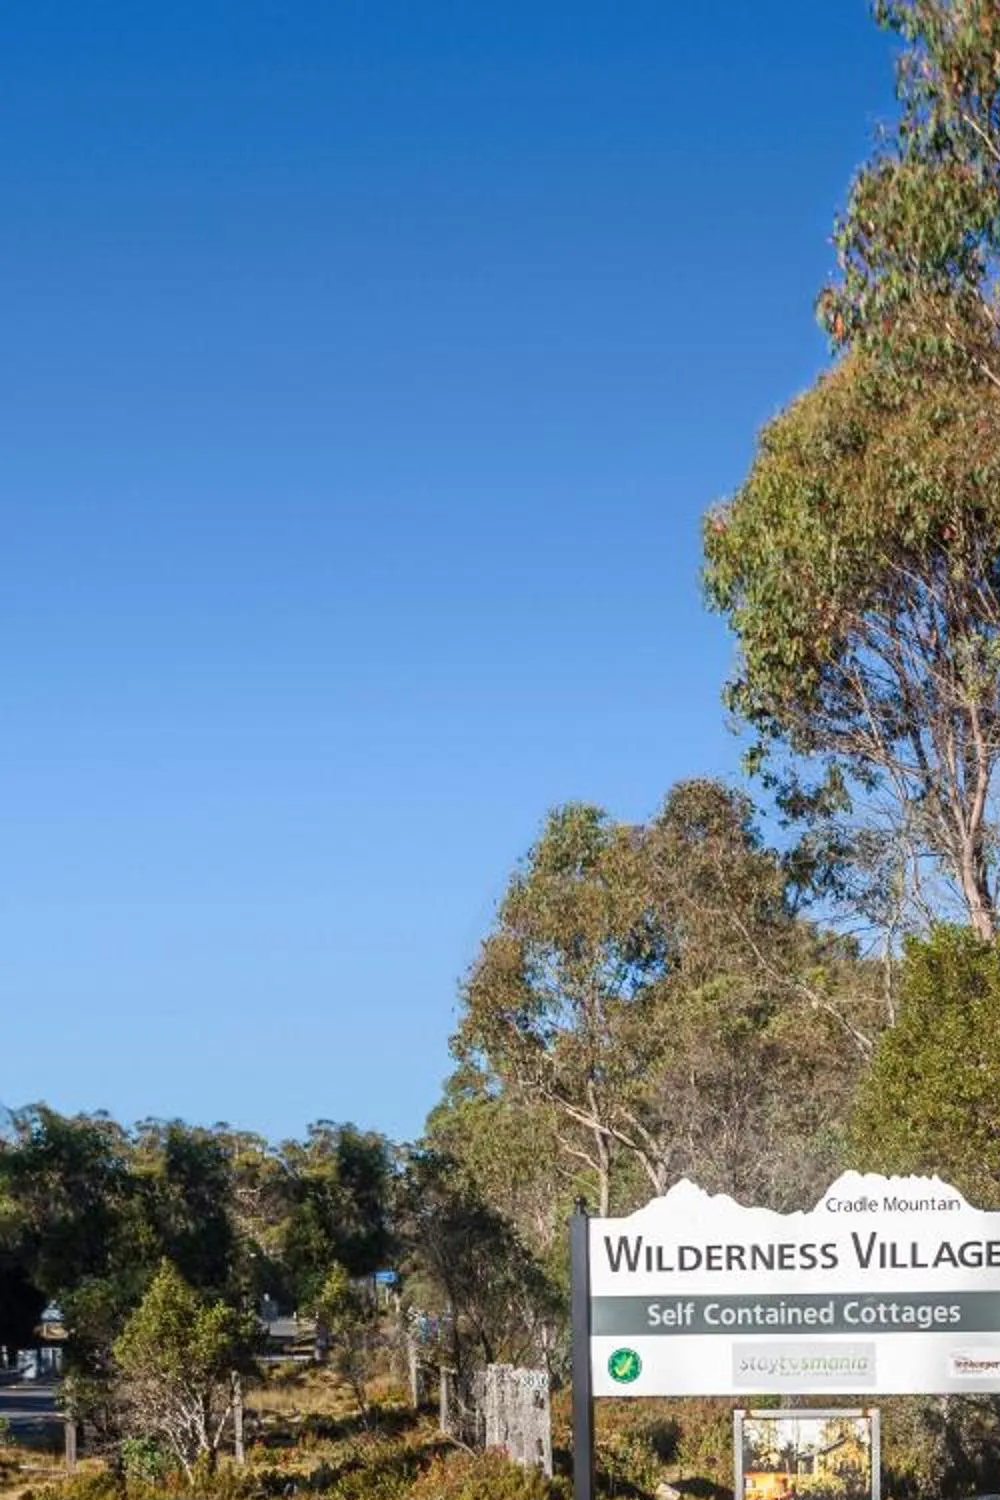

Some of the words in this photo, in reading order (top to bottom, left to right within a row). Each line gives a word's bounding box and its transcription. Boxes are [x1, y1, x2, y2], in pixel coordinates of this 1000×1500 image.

[825, 1196, 879, 1213] Cradle
[883, 1196, 960, 1213] Mountain
[603, 1234, 839, 1273] WILDERNESS
[647, 1303, 695, 1326] Self
[703, 1301, 835, 1326] Contained
[843, 1300, 962, 1328] Cottages
